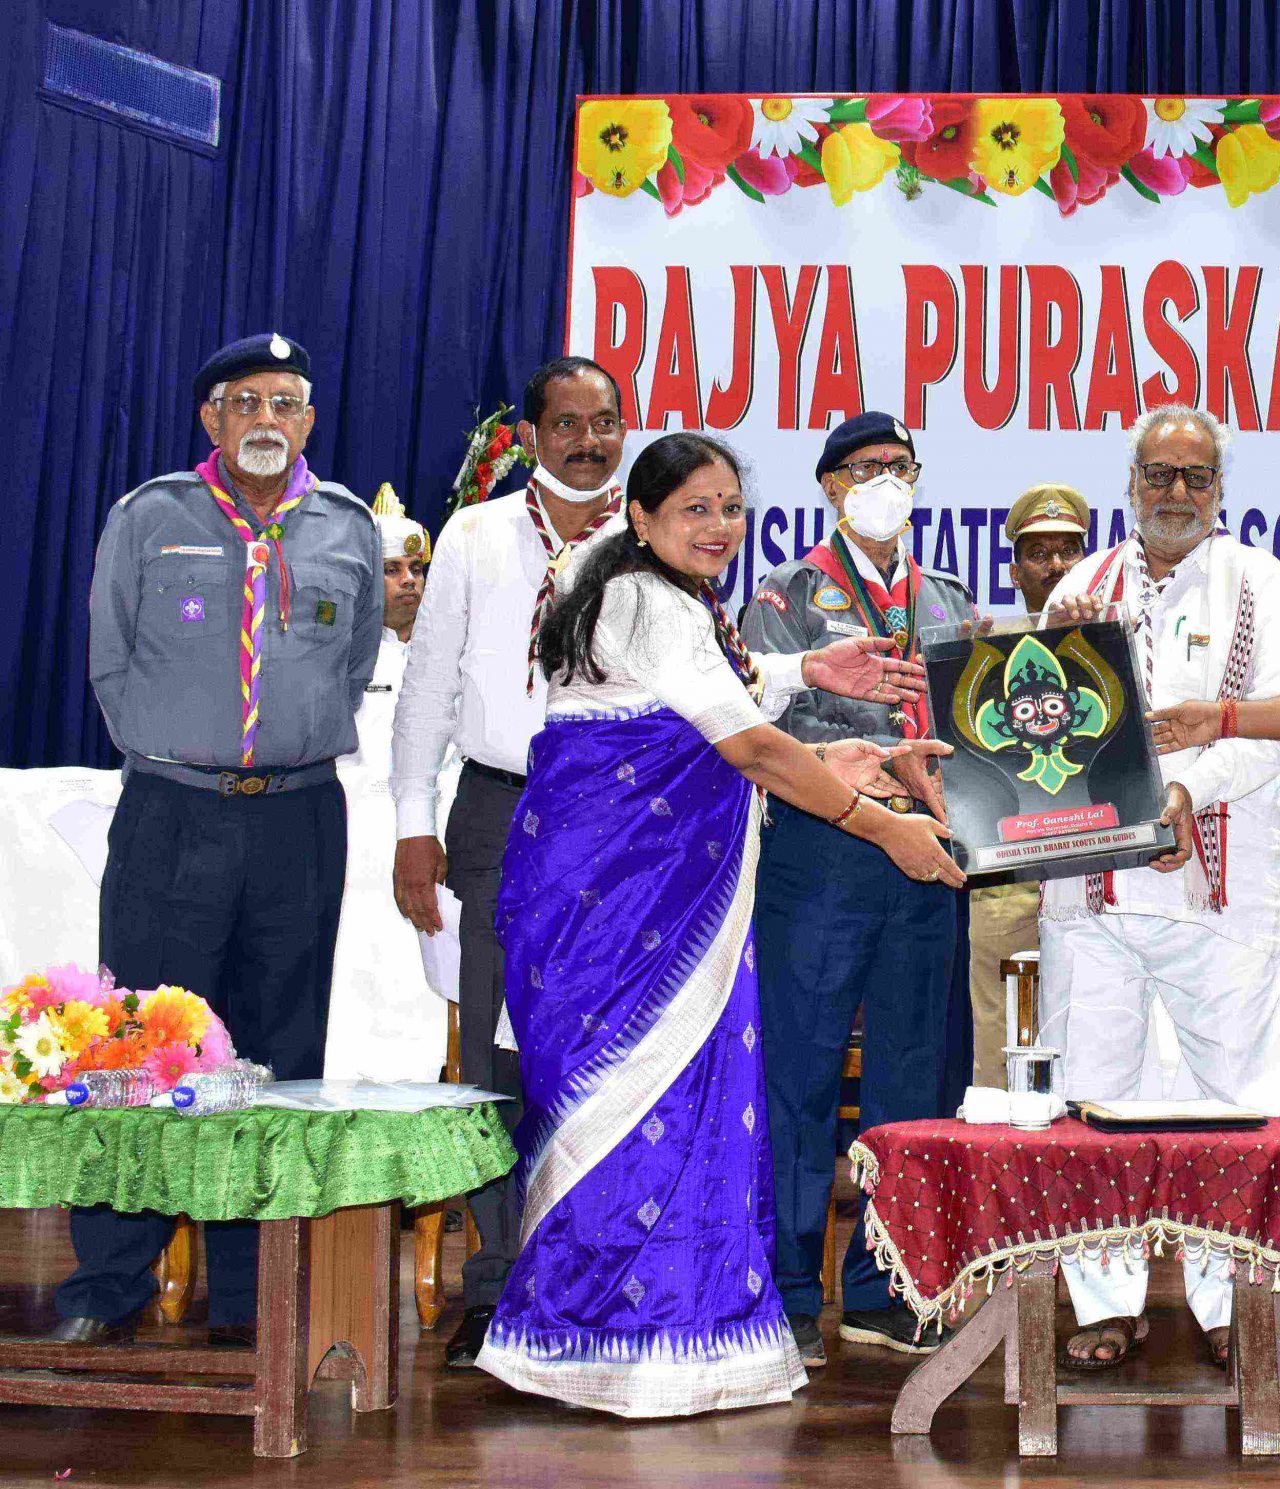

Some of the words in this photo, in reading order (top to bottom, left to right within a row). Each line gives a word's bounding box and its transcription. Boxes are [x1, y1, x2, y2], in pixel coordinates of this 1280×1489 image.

[591, 264, 866, 430] RAJYA
[911, 506, 1016, 605] TATE
[996, 848, 1021, 859] ODISHA
[1023, 845, 1042, 855] STATE
[1044, 841, 1070, 852] BHARAT
[1072, 837, 1097, 848] SCOUTS
[1097, 835, 1111, 844] AND
[1112, 831, 1137, 841] GUIDES
[1015, 818, 1039, 828] Prof.
[1043, 812, 1084, 825] Ganeshi
[1087, 809, 1104, 819] Lal
